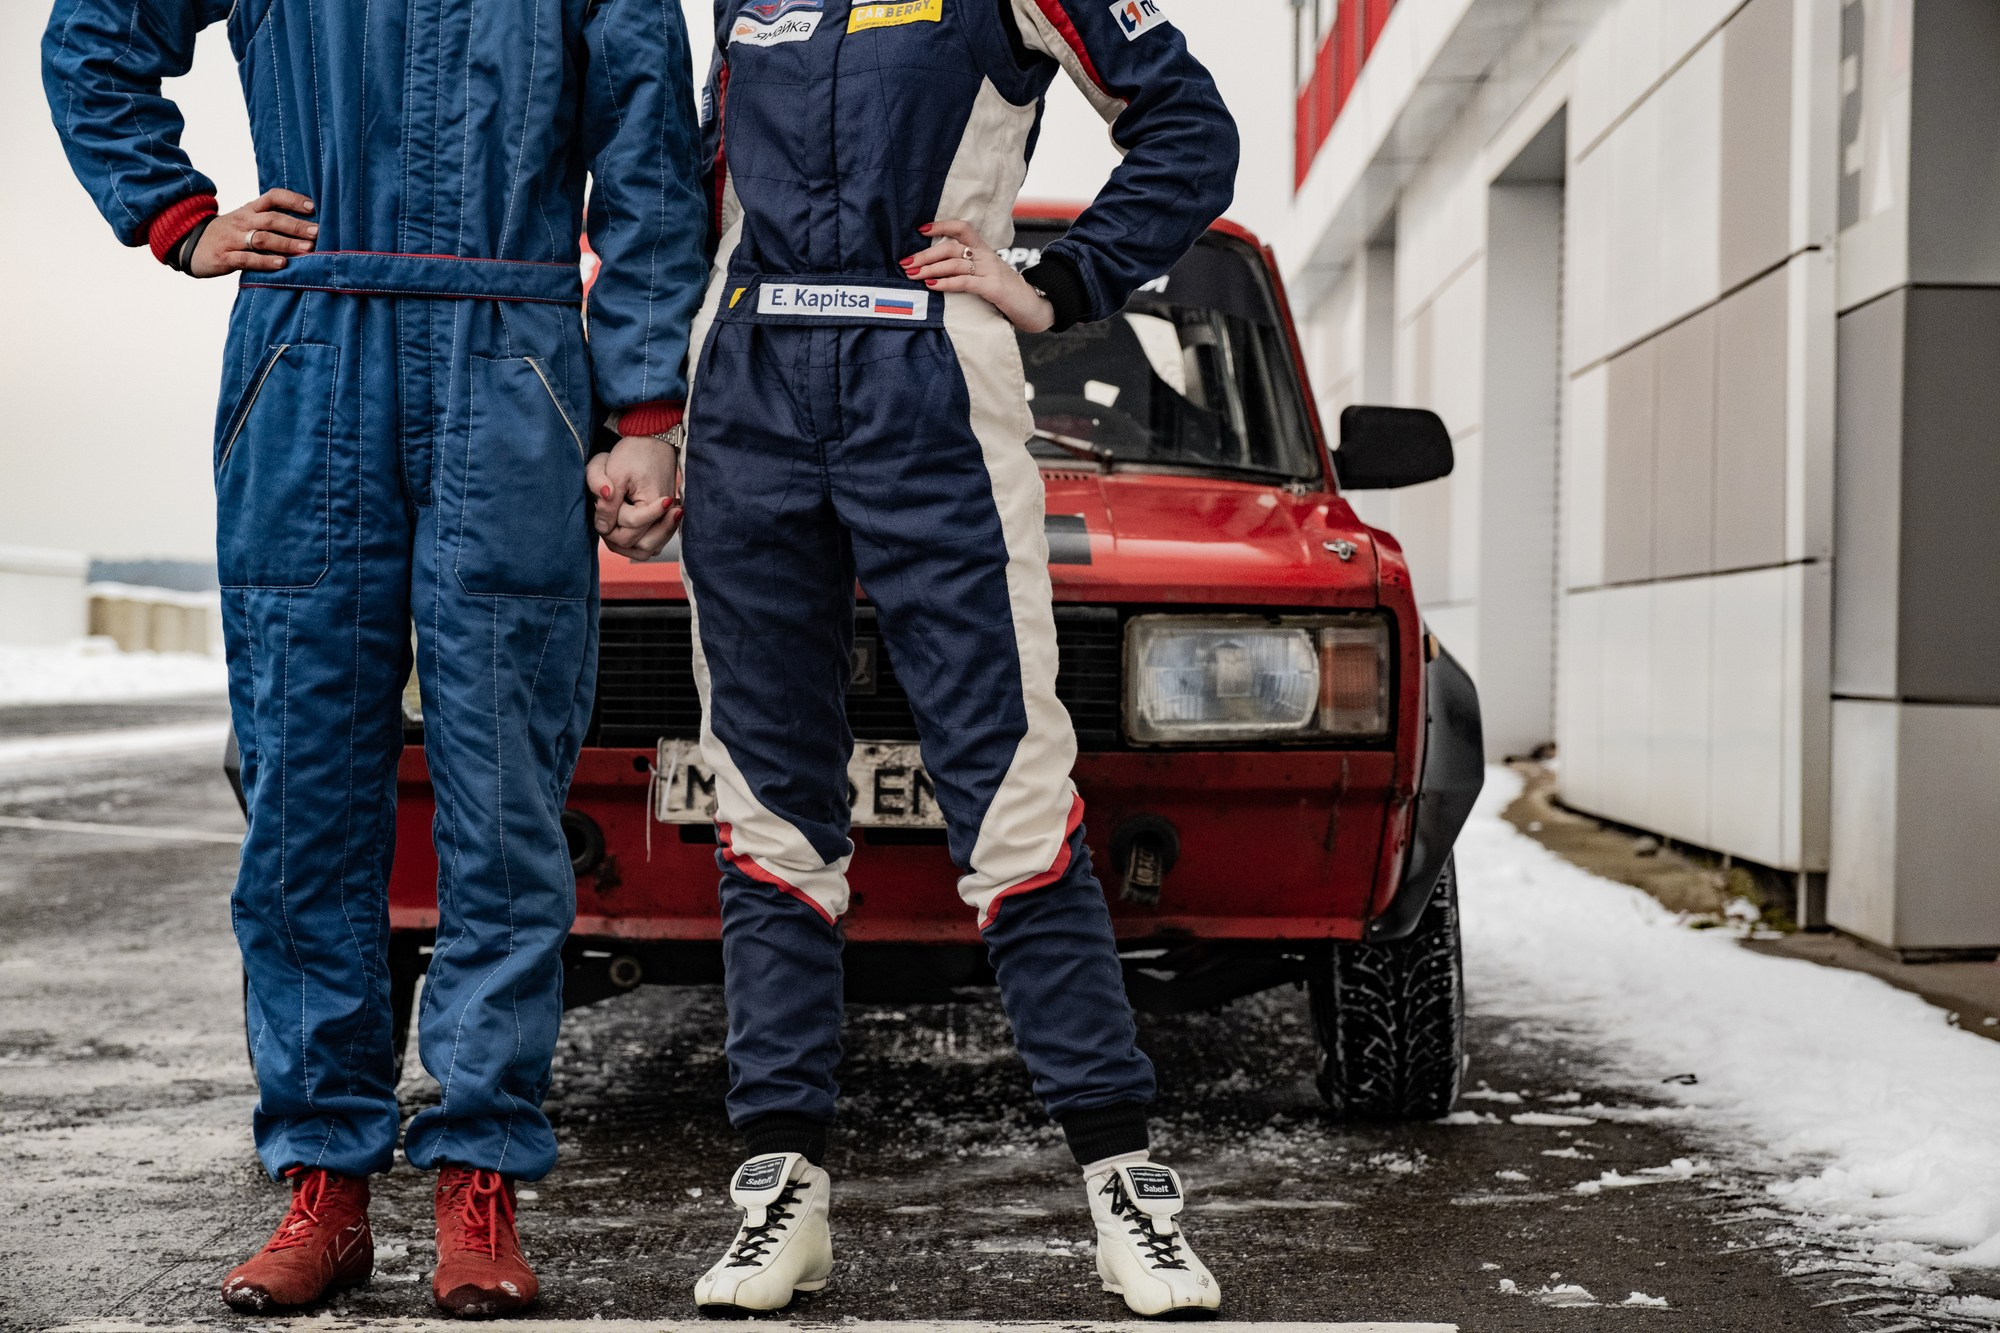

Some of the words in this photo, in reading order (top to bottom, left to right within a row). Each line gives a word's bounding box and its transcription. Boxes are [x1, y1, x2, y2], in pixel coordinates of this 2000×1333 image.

[771, 288, 788, 306] E.
[794, 288, 870, 312] Kapitsa
[1143, 1184, 1169, 1193] Sabelt
